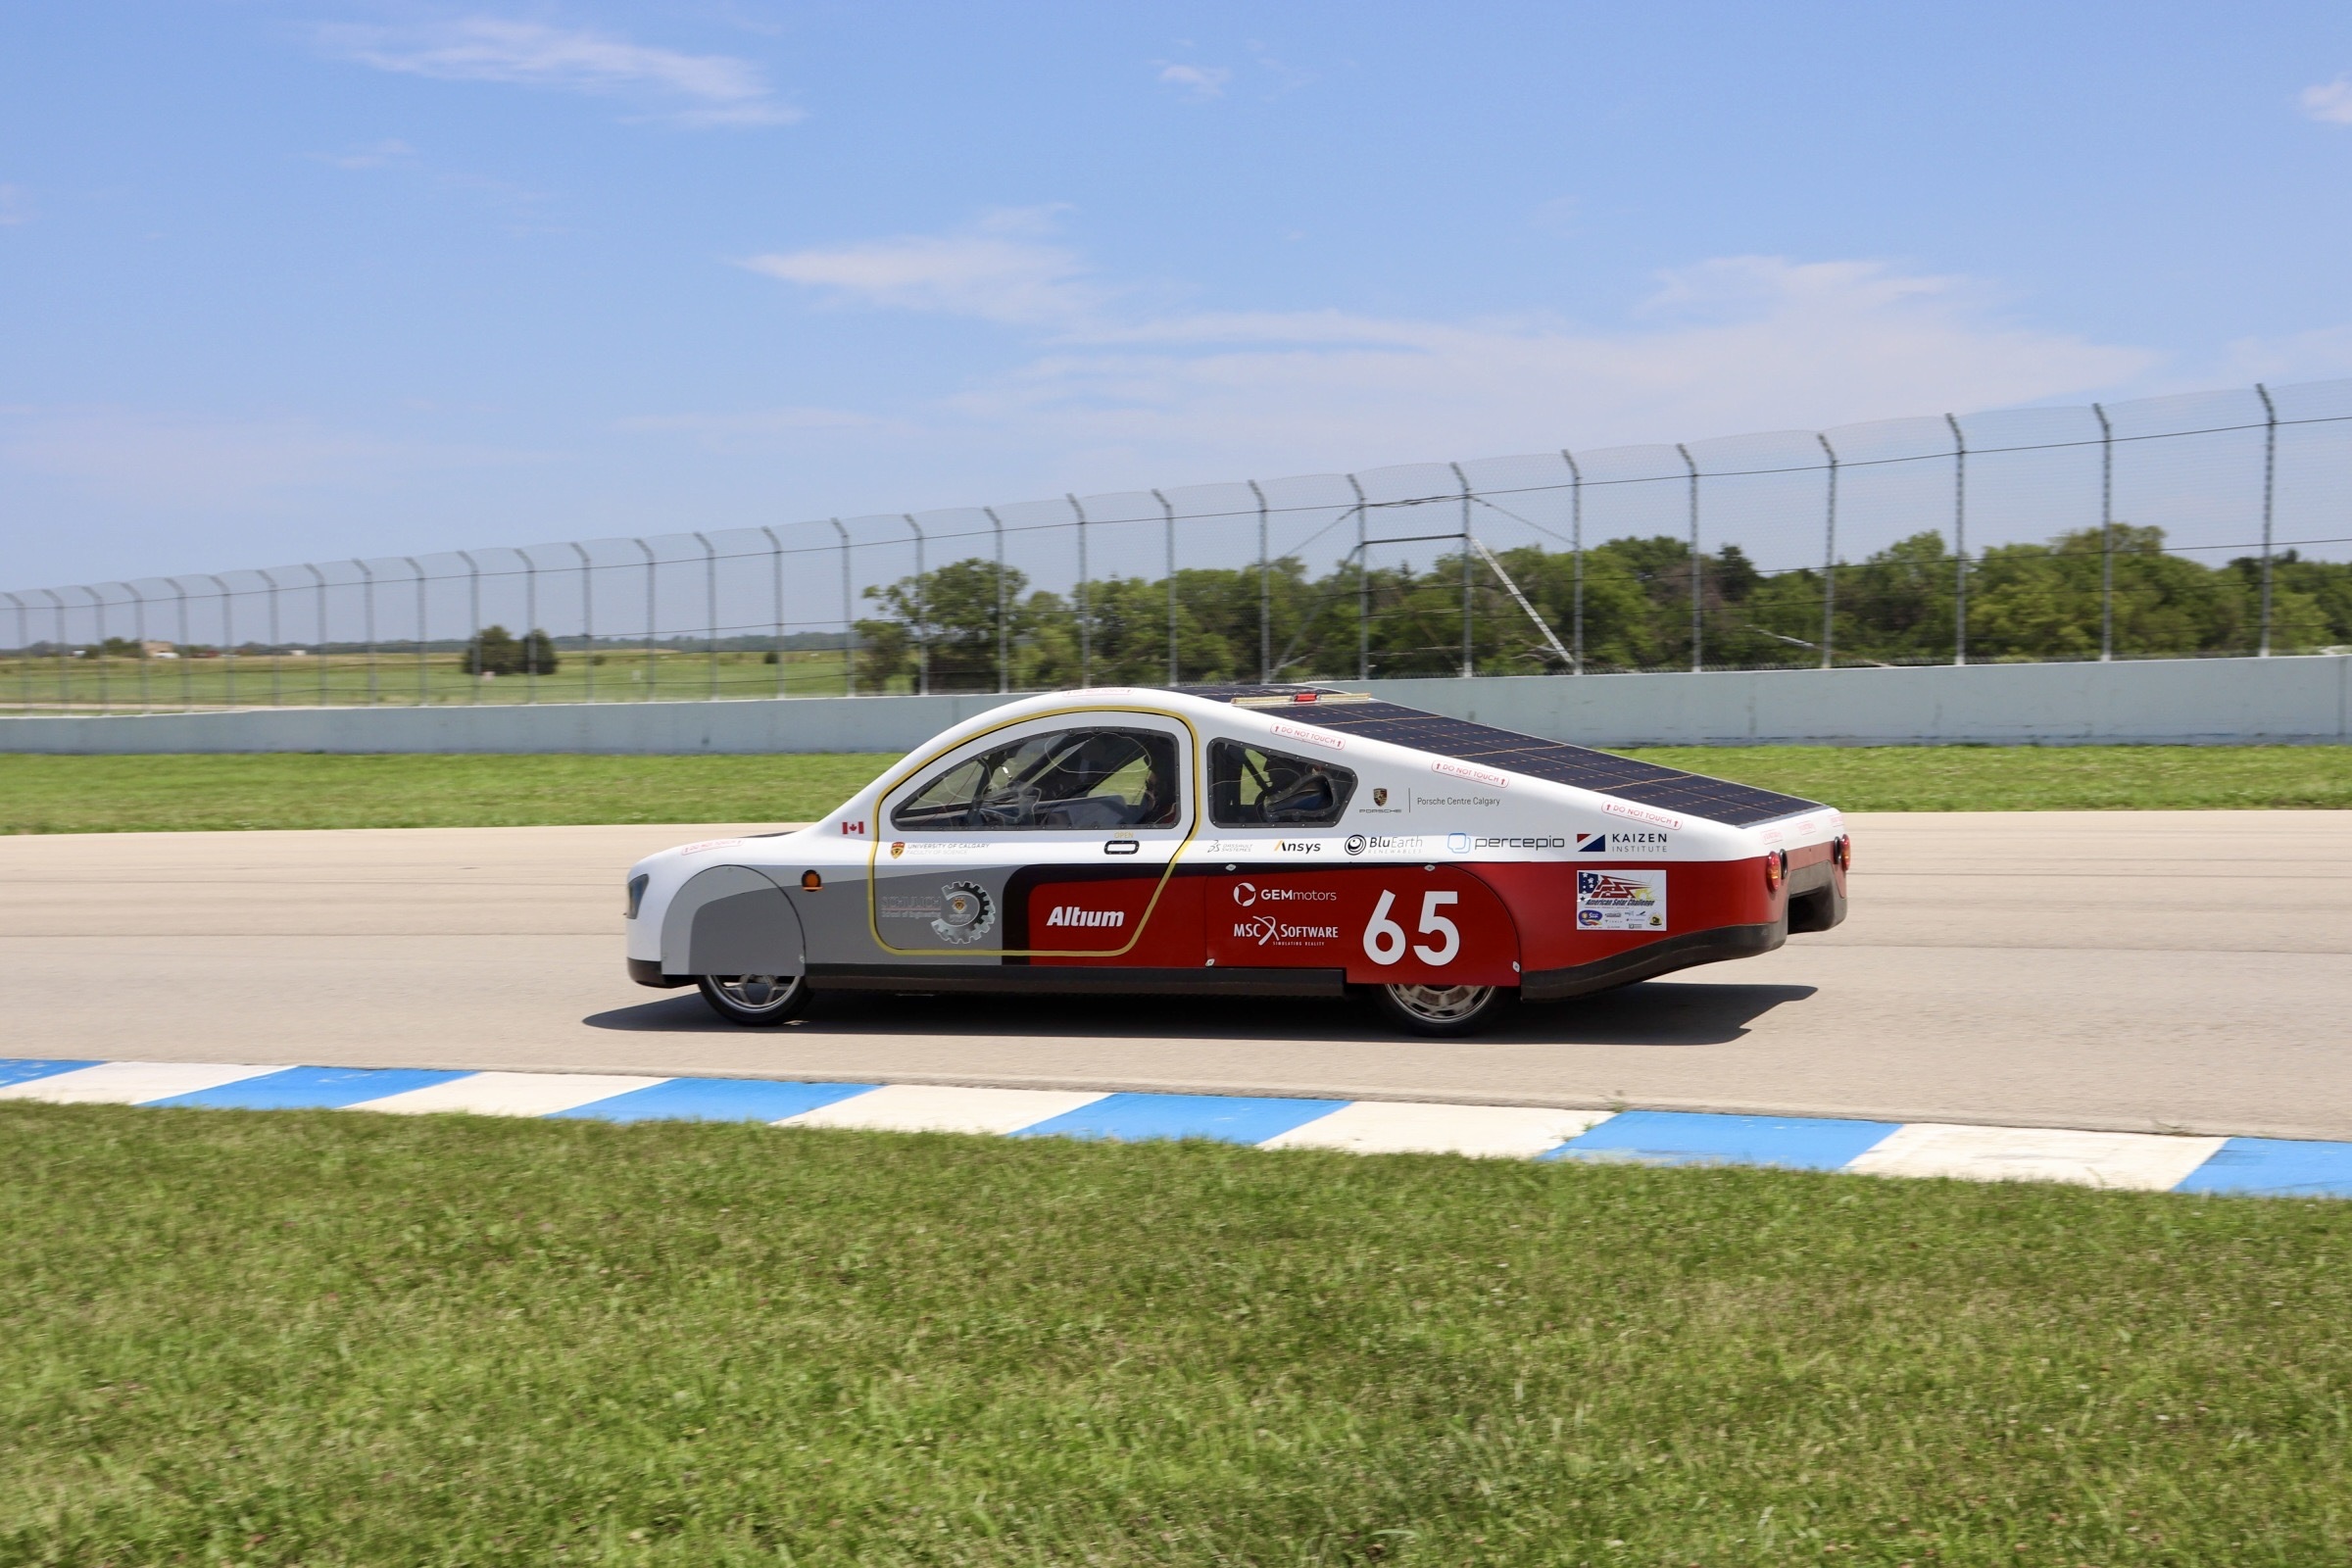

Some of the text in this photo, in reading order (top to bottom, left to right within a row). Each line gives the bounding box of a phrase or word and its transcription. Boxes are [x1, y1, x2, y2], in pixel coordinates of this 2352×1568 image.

[1311, 734, 1336, 744] TOUCH
[1474, 771, 1499, 782] TOUCH
[1473, 797, 1500, 807] Calgary
[1645, 812, 1672, 823] TOUCH
[1369, 836, 1423, 848] BluEarth
[1475, 835, 1565, 851] percepio
[1612, 833, 1668, 843] KAIZEN
[1274, 840, 1321, 854] Ansys
[1260, 889, 1337, 901] GEMmotors
[1046, 906, 1125, 927] Altium
[1234, 923, 1261, 937] MSC
[1362, 889, 1460, 966] 65
